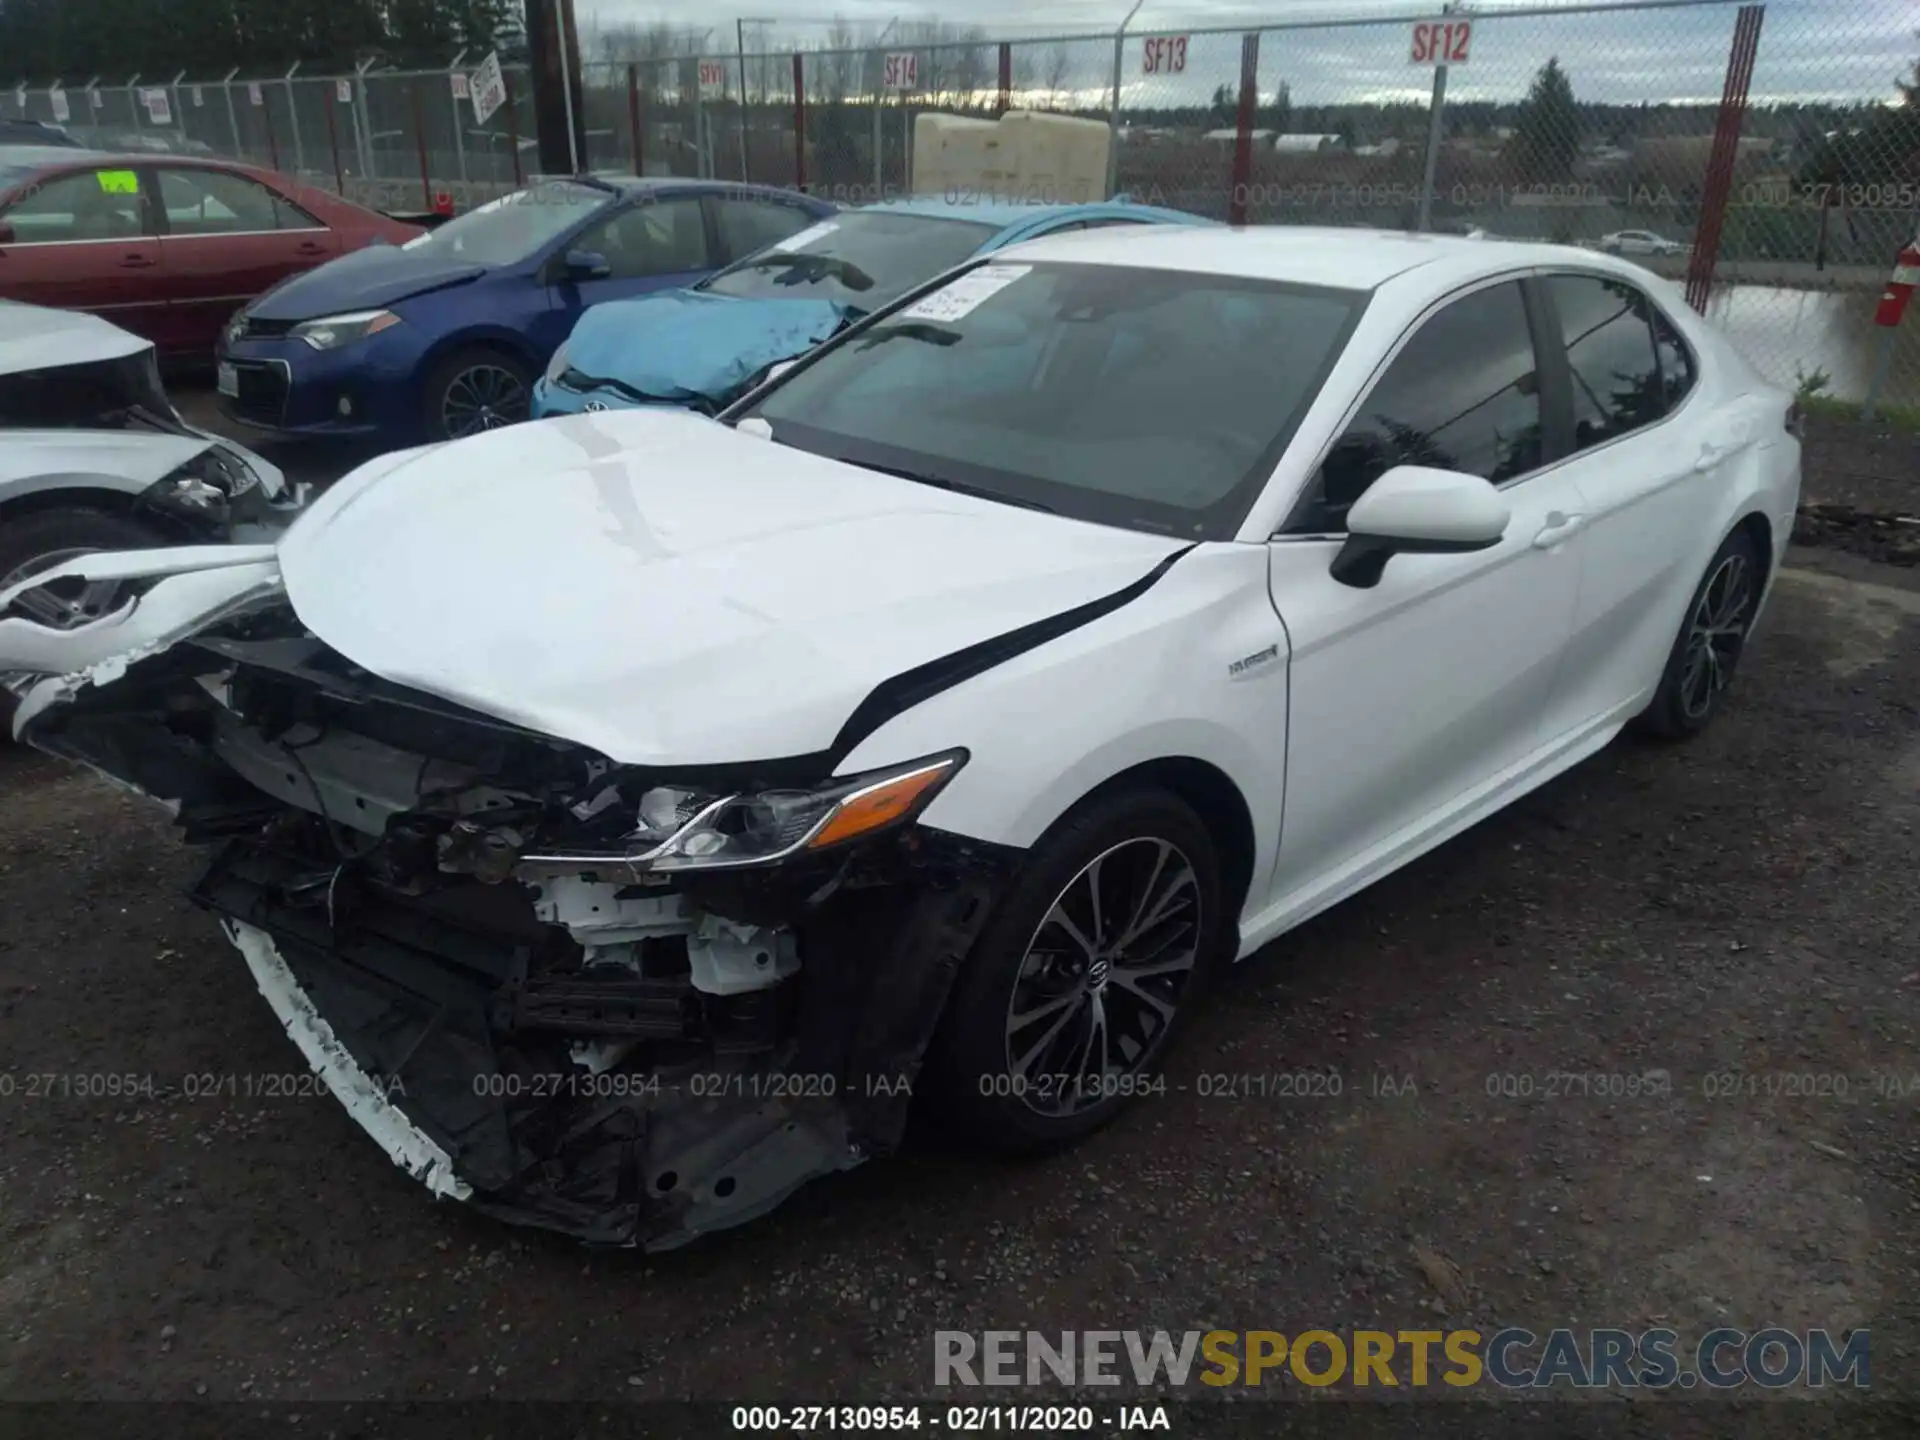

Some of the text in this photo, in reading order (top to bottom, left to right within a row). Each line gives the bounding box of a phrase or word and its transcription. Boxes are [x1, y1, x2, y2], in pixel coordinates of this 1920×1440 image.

[1144, 36, 1187, 73] SF13
[1412, 22, 1470, 61] SF12
[886, 54, 916, 86] SF14
